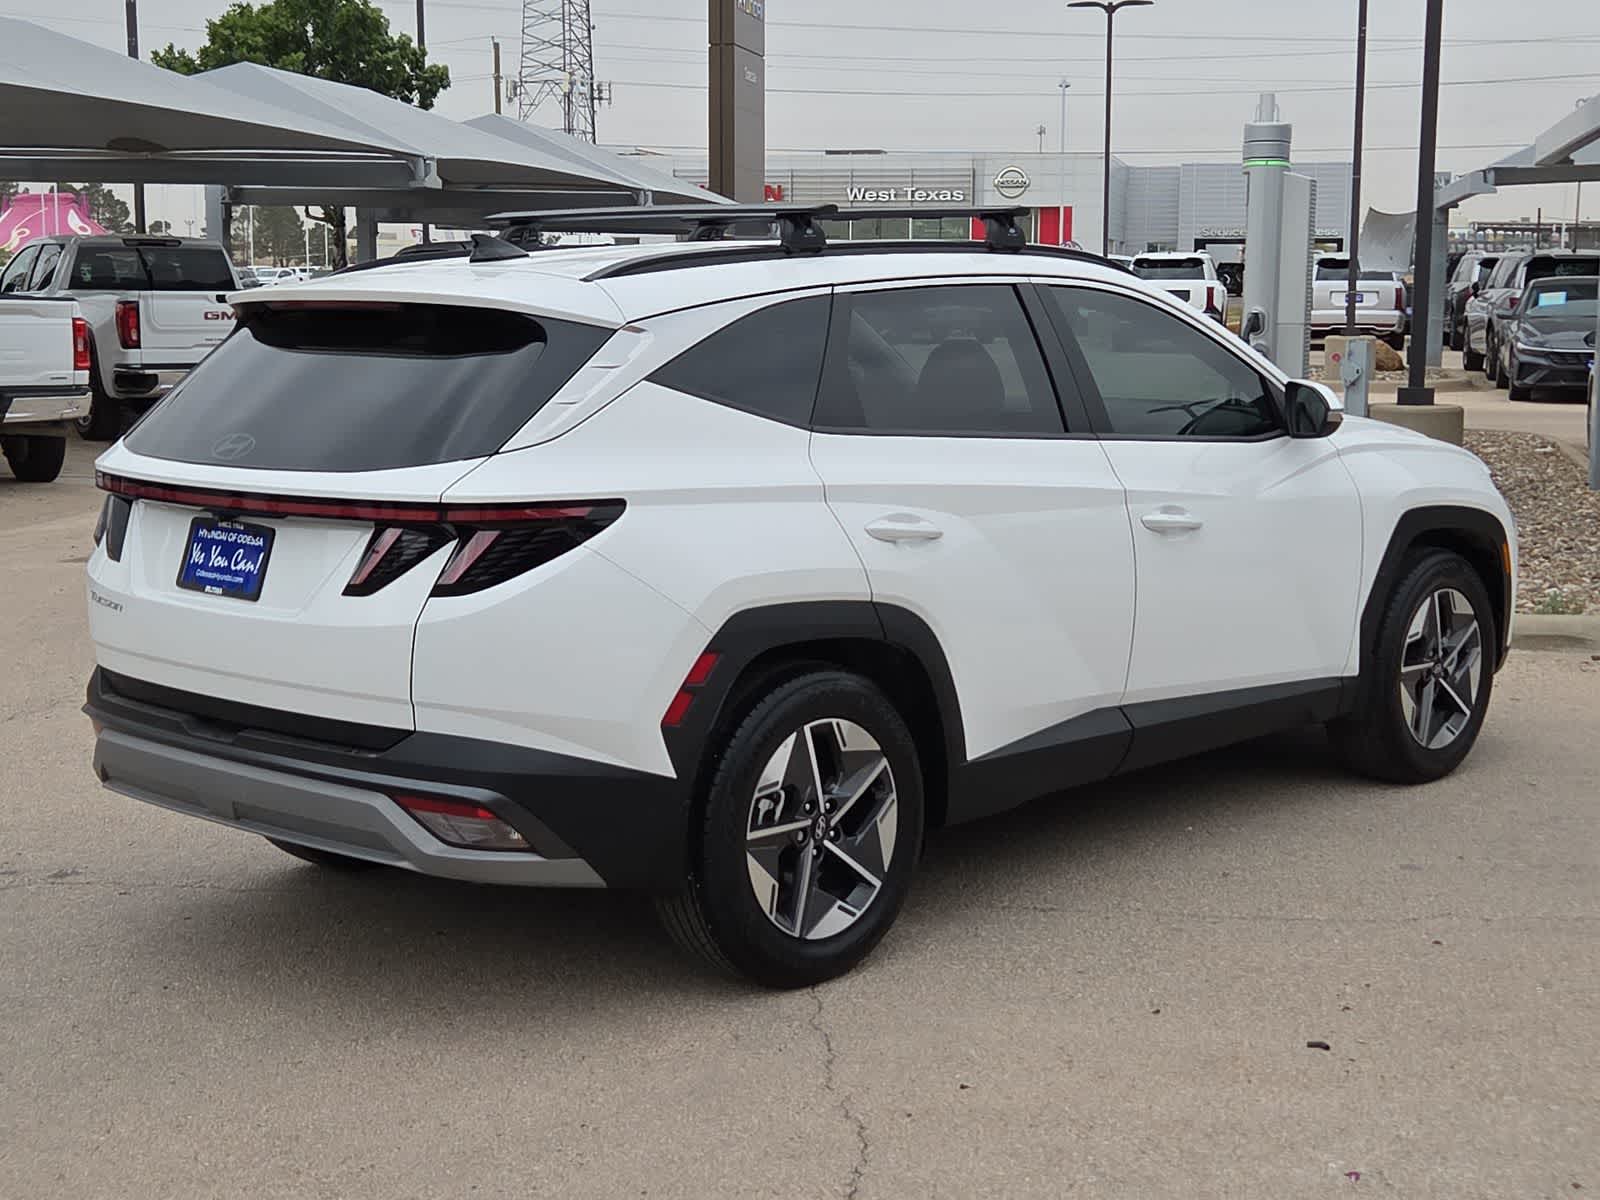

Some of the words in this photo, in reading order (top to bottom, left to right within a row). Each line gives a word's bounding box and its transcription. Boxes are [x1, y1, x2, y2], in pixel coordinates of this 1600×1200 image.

[846, 187, 897, 202] West
[903, 187, 964, 202] Texas
[204, 311, 237, 320] GM
[198, 528, 227, 541] HYUNDAI
[227, 532, 238, 542] OF
[237, 534, 264, 547] ODESSA
[191, 543, 205, 565] Yes
[208, 545, 228, 568] You
[230, 548, 264, 575] Can!
